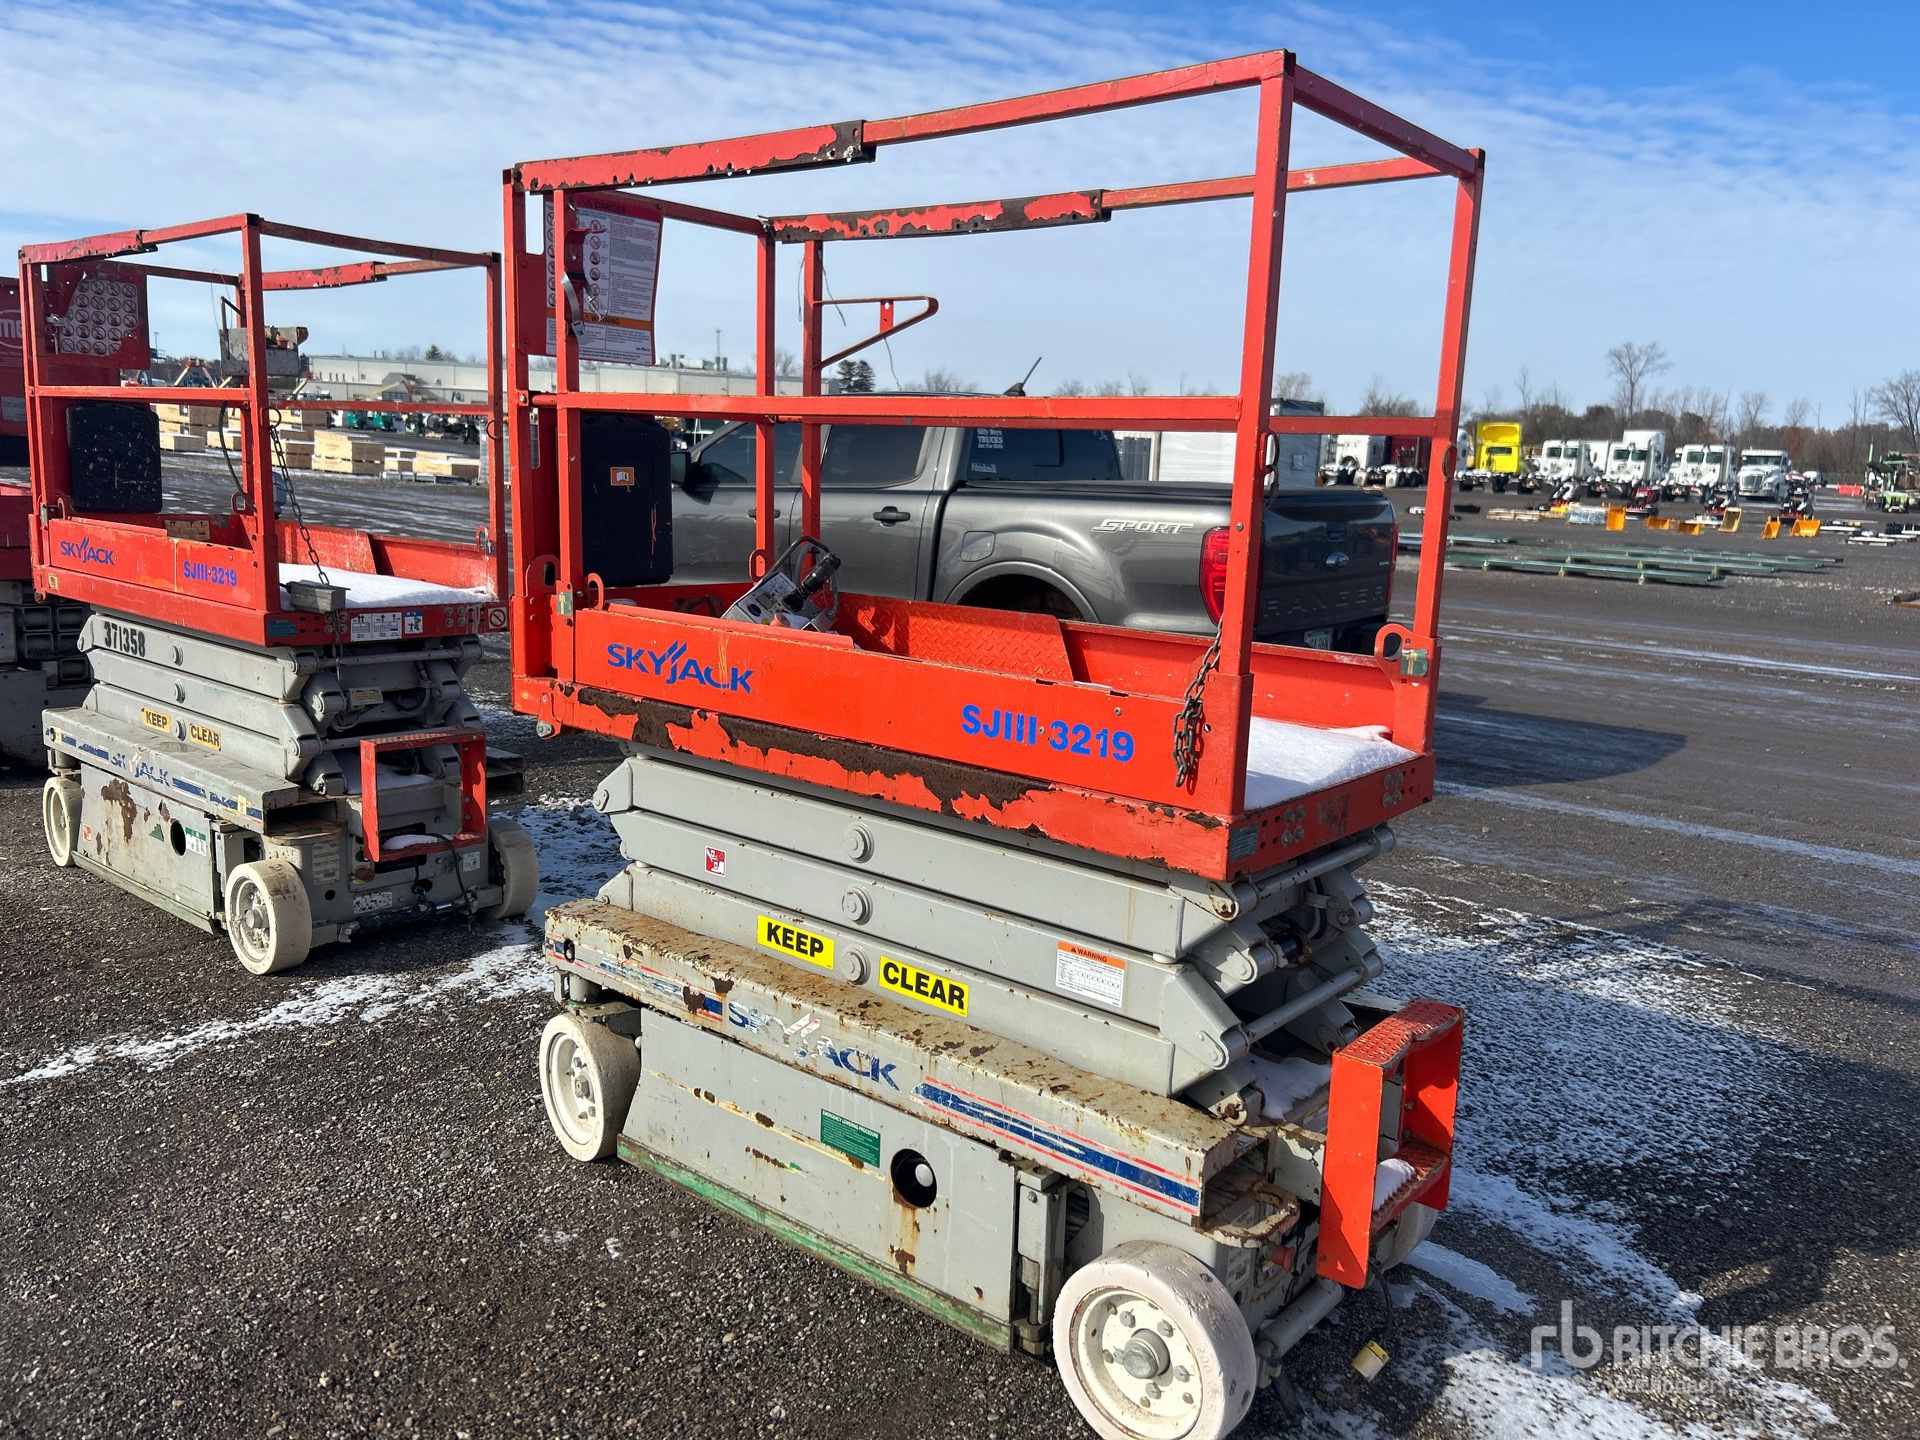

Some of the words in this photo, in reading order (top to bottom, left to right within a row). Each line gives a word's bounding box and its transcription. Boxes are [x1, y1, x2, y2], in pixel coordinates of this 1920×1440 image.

[1091, 519, 1194, 535] SPORT
[60, 536, 115, 566] SKYJACK
[104, 621, 146, 658] 371358
[607, 640, 754, 694] SKYJACK
[145, 710, 168, 729] KEEP
[190, 725, 220, 747] CLEAR
[766, 922, 824, 958] KEEP
[883, 962, 965, 1011] CLEAR
[1077, 948, 1108, 963] WARNING
